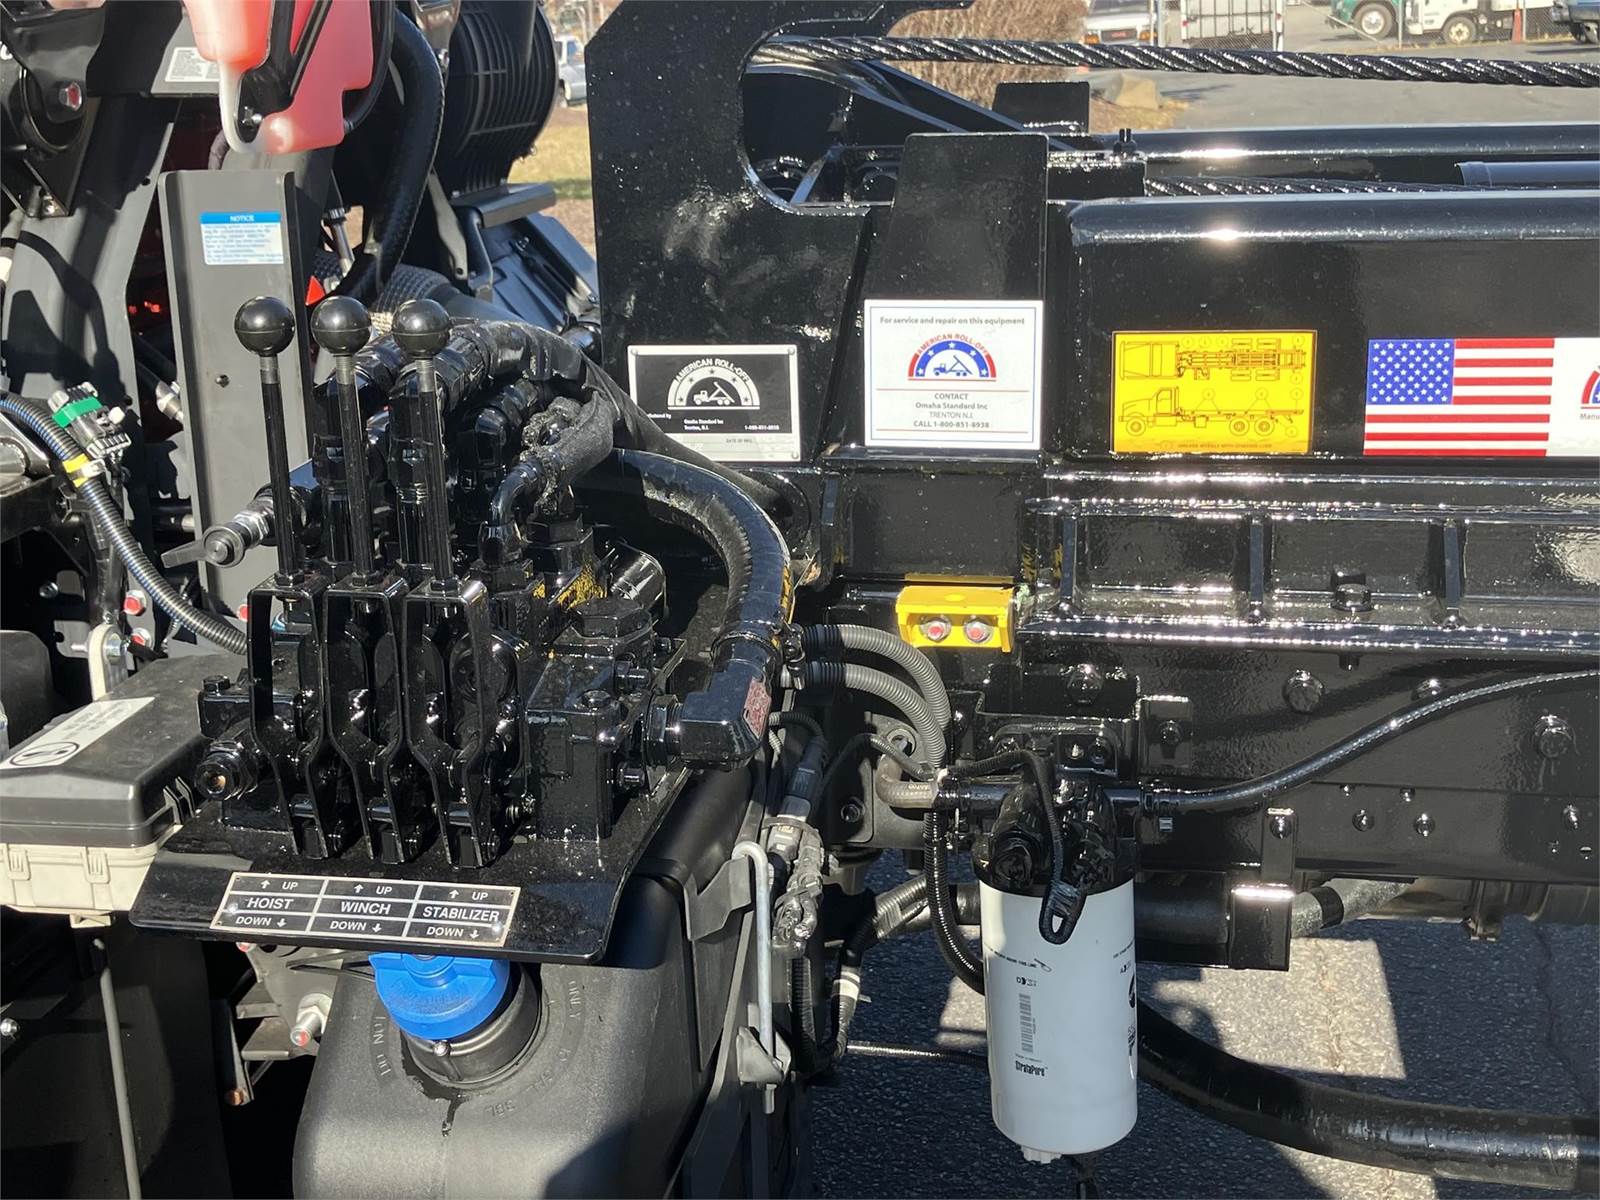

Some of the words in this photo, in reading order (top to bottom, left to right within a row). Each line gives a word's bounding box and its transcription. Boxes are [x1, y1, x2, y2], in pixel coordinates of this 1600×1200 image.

[880, 316, 892, 324] For
[893, 316, 918, 324] service
[920, 316, 934, 324] and
[935, 317, 957, 326] repair
[969, 317, 983, 325] this
[984, 317, 1025, 327] equipment
[917, 333, 953, 355] AMERICAN
[674, 358, 713, 383] AMERICAN
[714, 358, 750, 382] ROLL-OFF
[934, 393, 969, 401] CONTACT
[943, 402, 976, 410] Standard
[929, 411, 961, 419] TRENTON
[913, 420, 932, 428] CALL
[933, 421, 990, 429] 1-800-851-8938
[281, 881, 299, 890] UP
[375, 885, 393, 895] UP
[471, 891, 489, 901] UP
[246, 897, 295, 910] HOIST
[341, 901, 392, 915] WINCH
[422, 906, 500, 922] STABILIZER
[235, 916, 272, 926] DOWN
[329, 920, 367, 931] DOWN
[426, 926, 464, 937] DOWN
